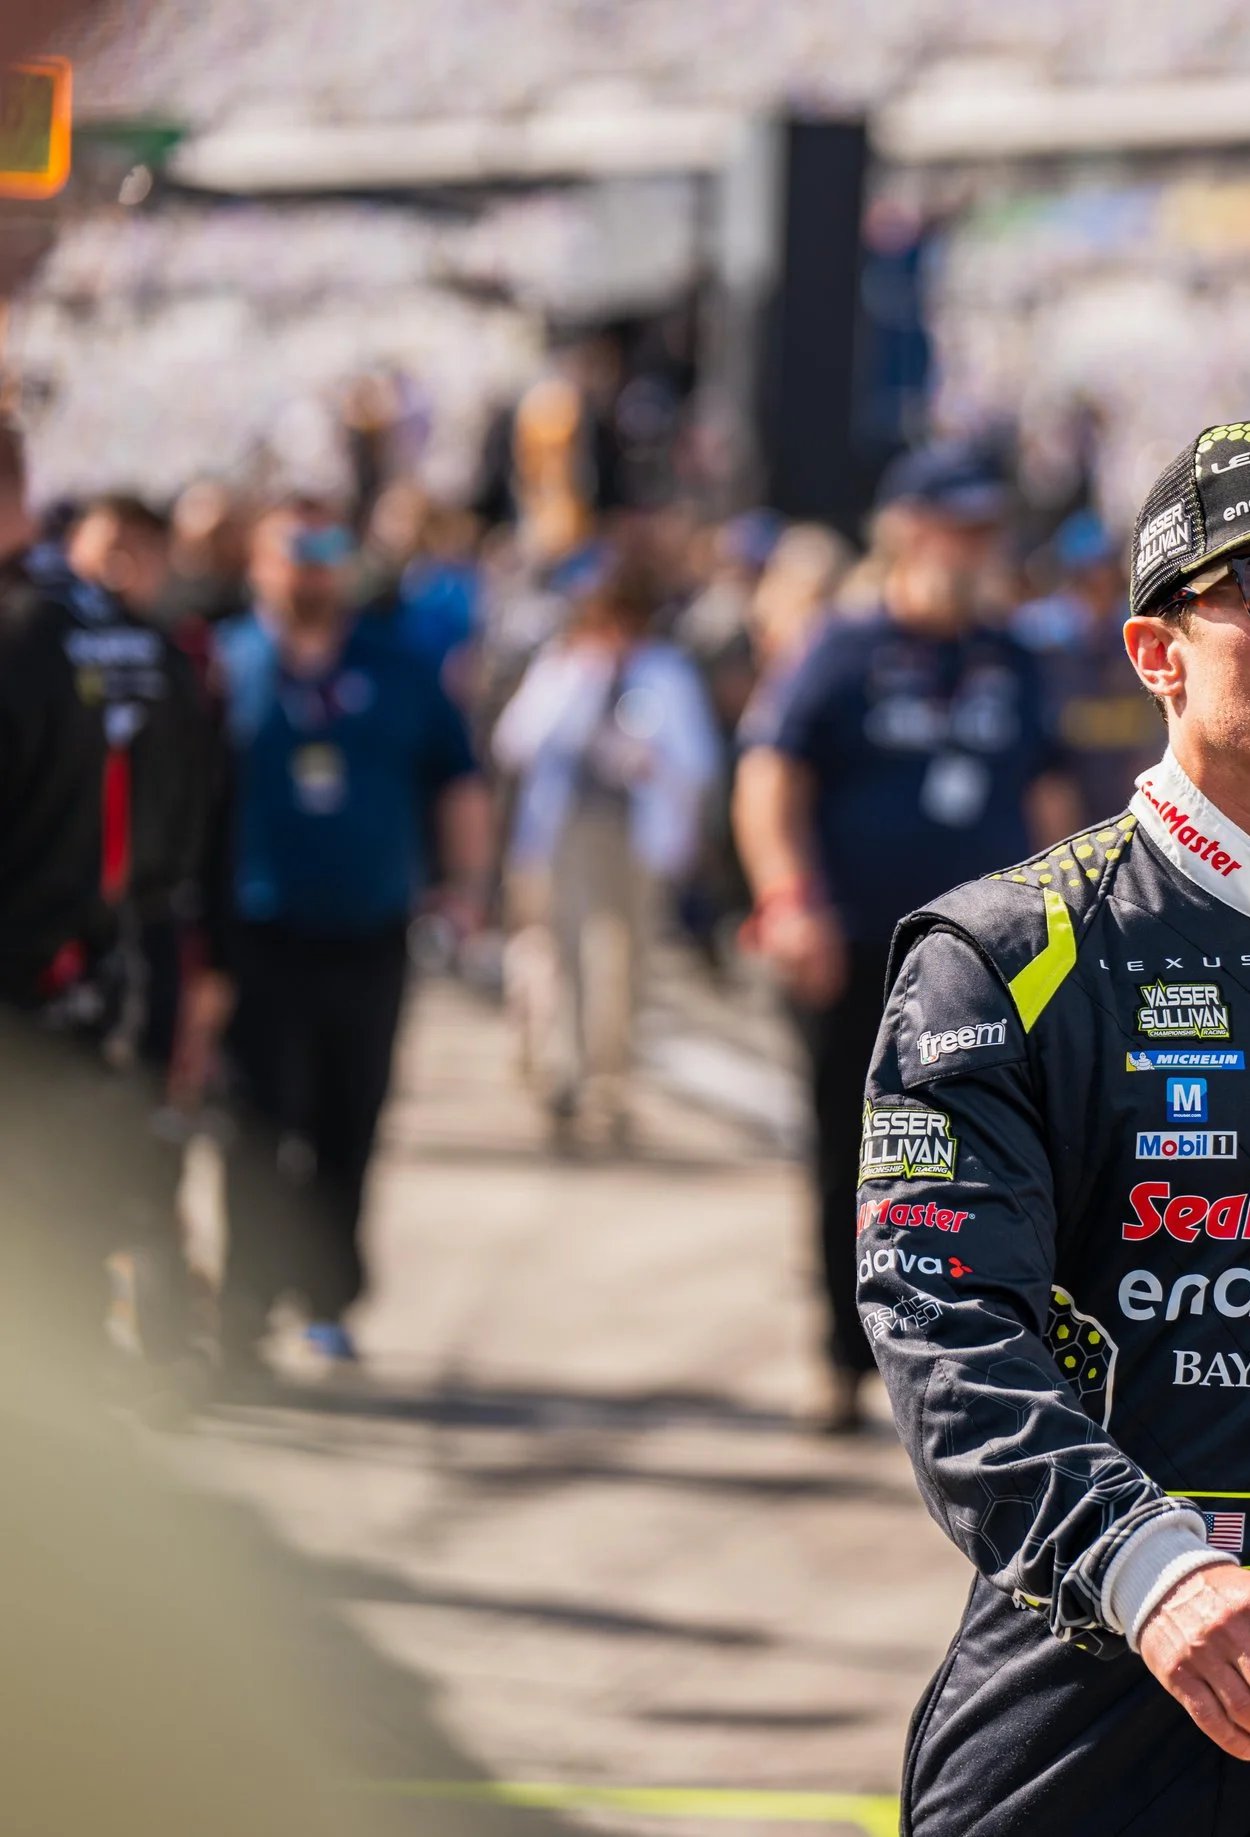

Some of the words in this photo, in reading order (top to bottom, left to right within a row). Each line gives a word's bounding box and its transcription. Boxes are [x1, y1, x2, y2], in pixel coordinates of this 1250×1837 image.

[1142, 985, 1220, 1008] VASSER
[1139, 1006, 1228, 1029] SULLIVAN
[917, 1020, 1005, 1064] freem
[1156, 1054, 1238, 1065] MICHELIN
[1173, 1084, 1202, 1111] M
[862, 1111, 946, 1137] ASSER
[1139, 1135, 1208, 1157] Mobil
[1218, 1136, 1227, 1155] 1
[915, 1165, 948, 1173] RACING
[857, 1198, 969, 1240] lMaster
[859, 1248, 943, 1284] dava
